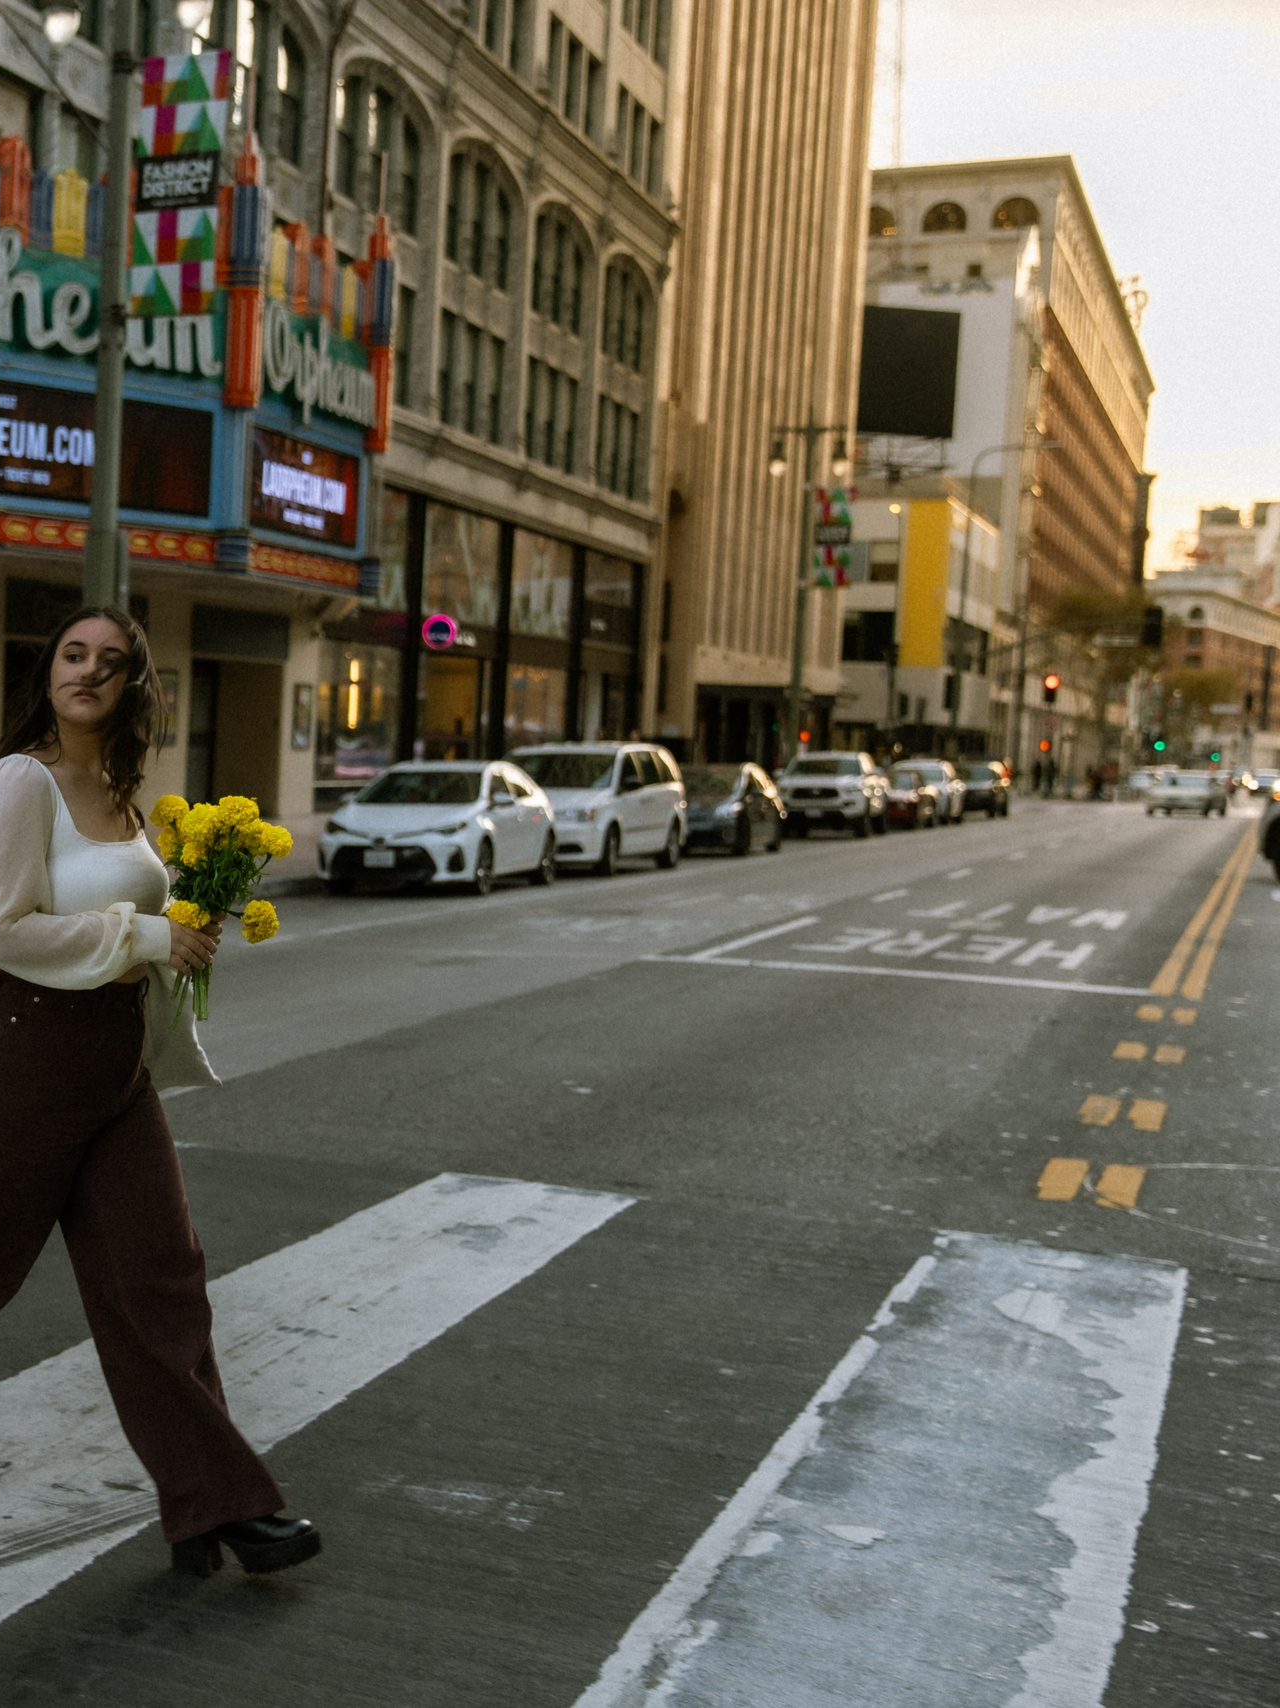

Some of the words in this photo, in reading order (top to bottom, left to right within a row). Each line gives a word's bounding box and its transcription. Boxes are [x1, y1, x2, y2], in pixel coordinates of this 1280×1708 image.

[143, 157, 214, 182] FASHION
[142, 177, 210, 199] DISTRICT
[265, 299, 378, 428] Orpheum
[792, 926, 1096, 971] HERE
